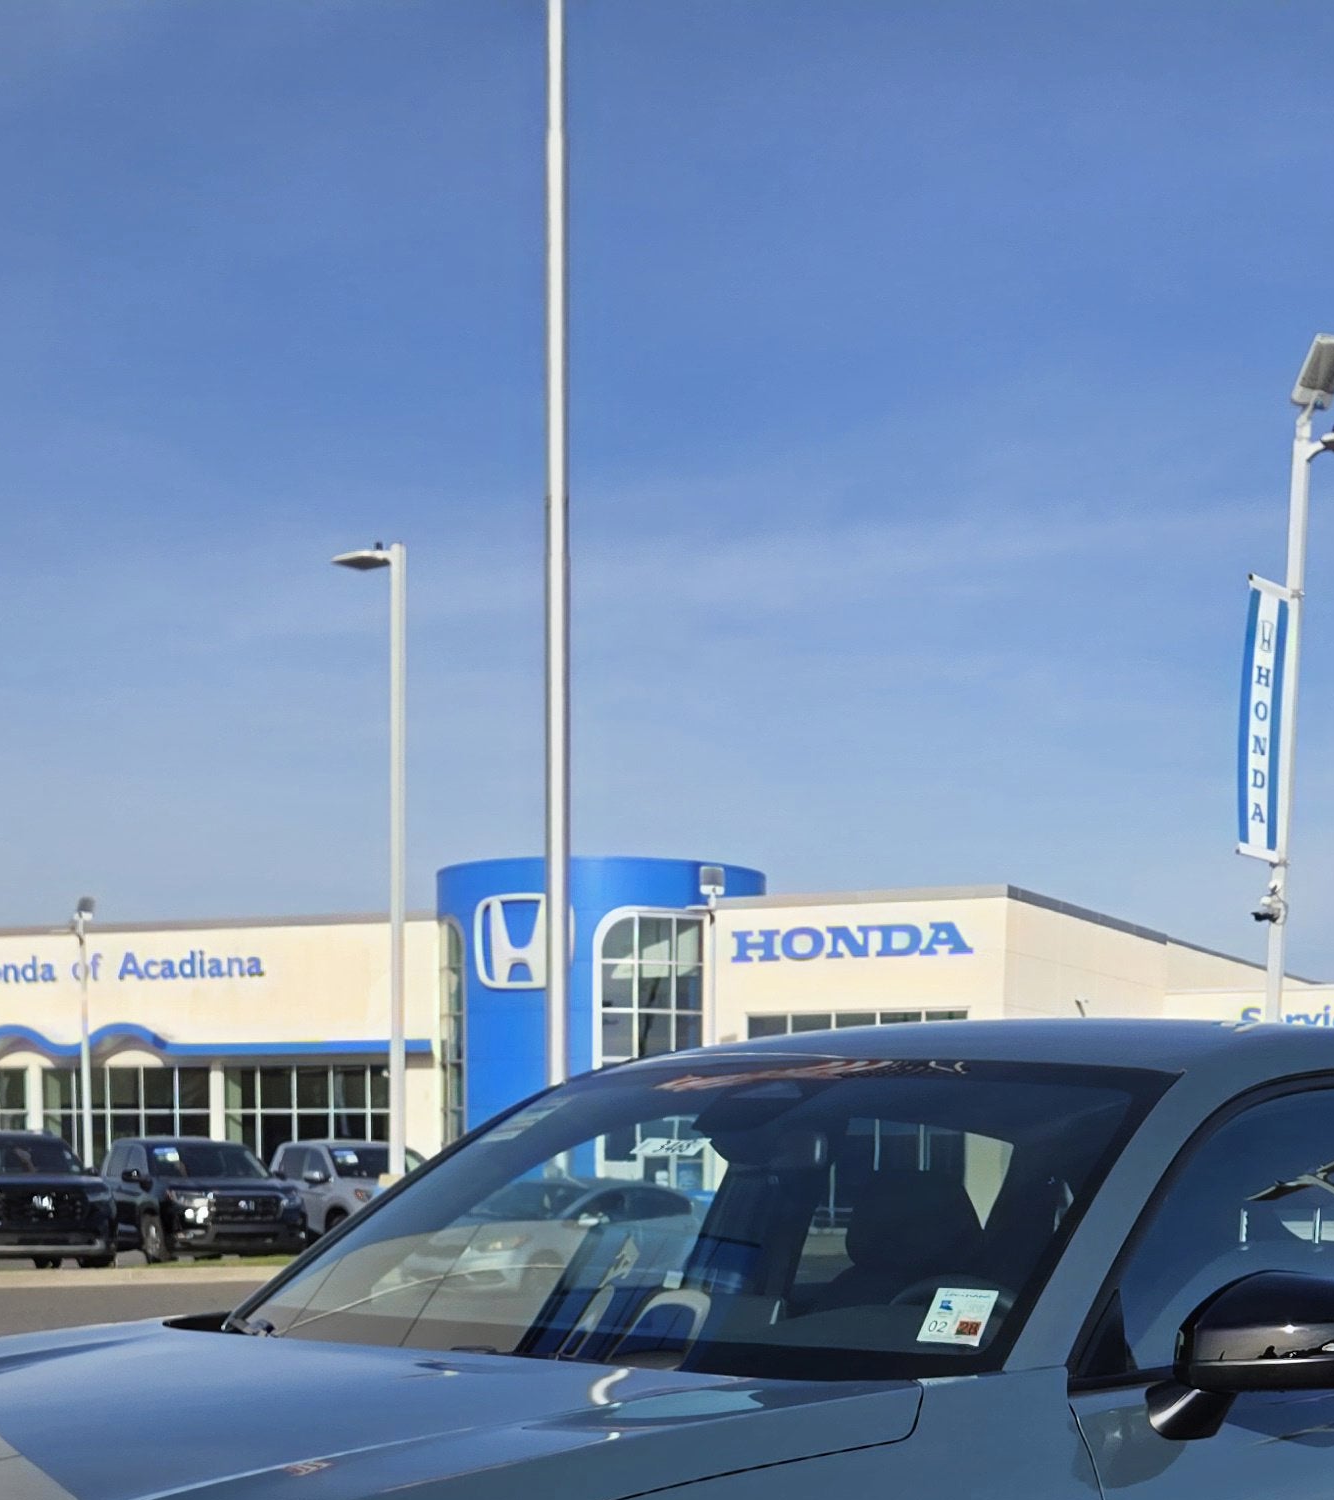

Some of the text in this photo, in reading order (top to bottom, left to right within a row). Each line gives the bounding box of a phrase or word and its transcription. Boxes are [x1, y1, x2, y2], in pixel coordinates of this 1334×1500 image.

[1250, 665, 1271, 824] HONDA
[730, 921, 974, 962] HONDA
[71, 952, 103, 982] of
[118, 950, 265, 981] Acadiana
[928, 1320, 948, 1333] 02
